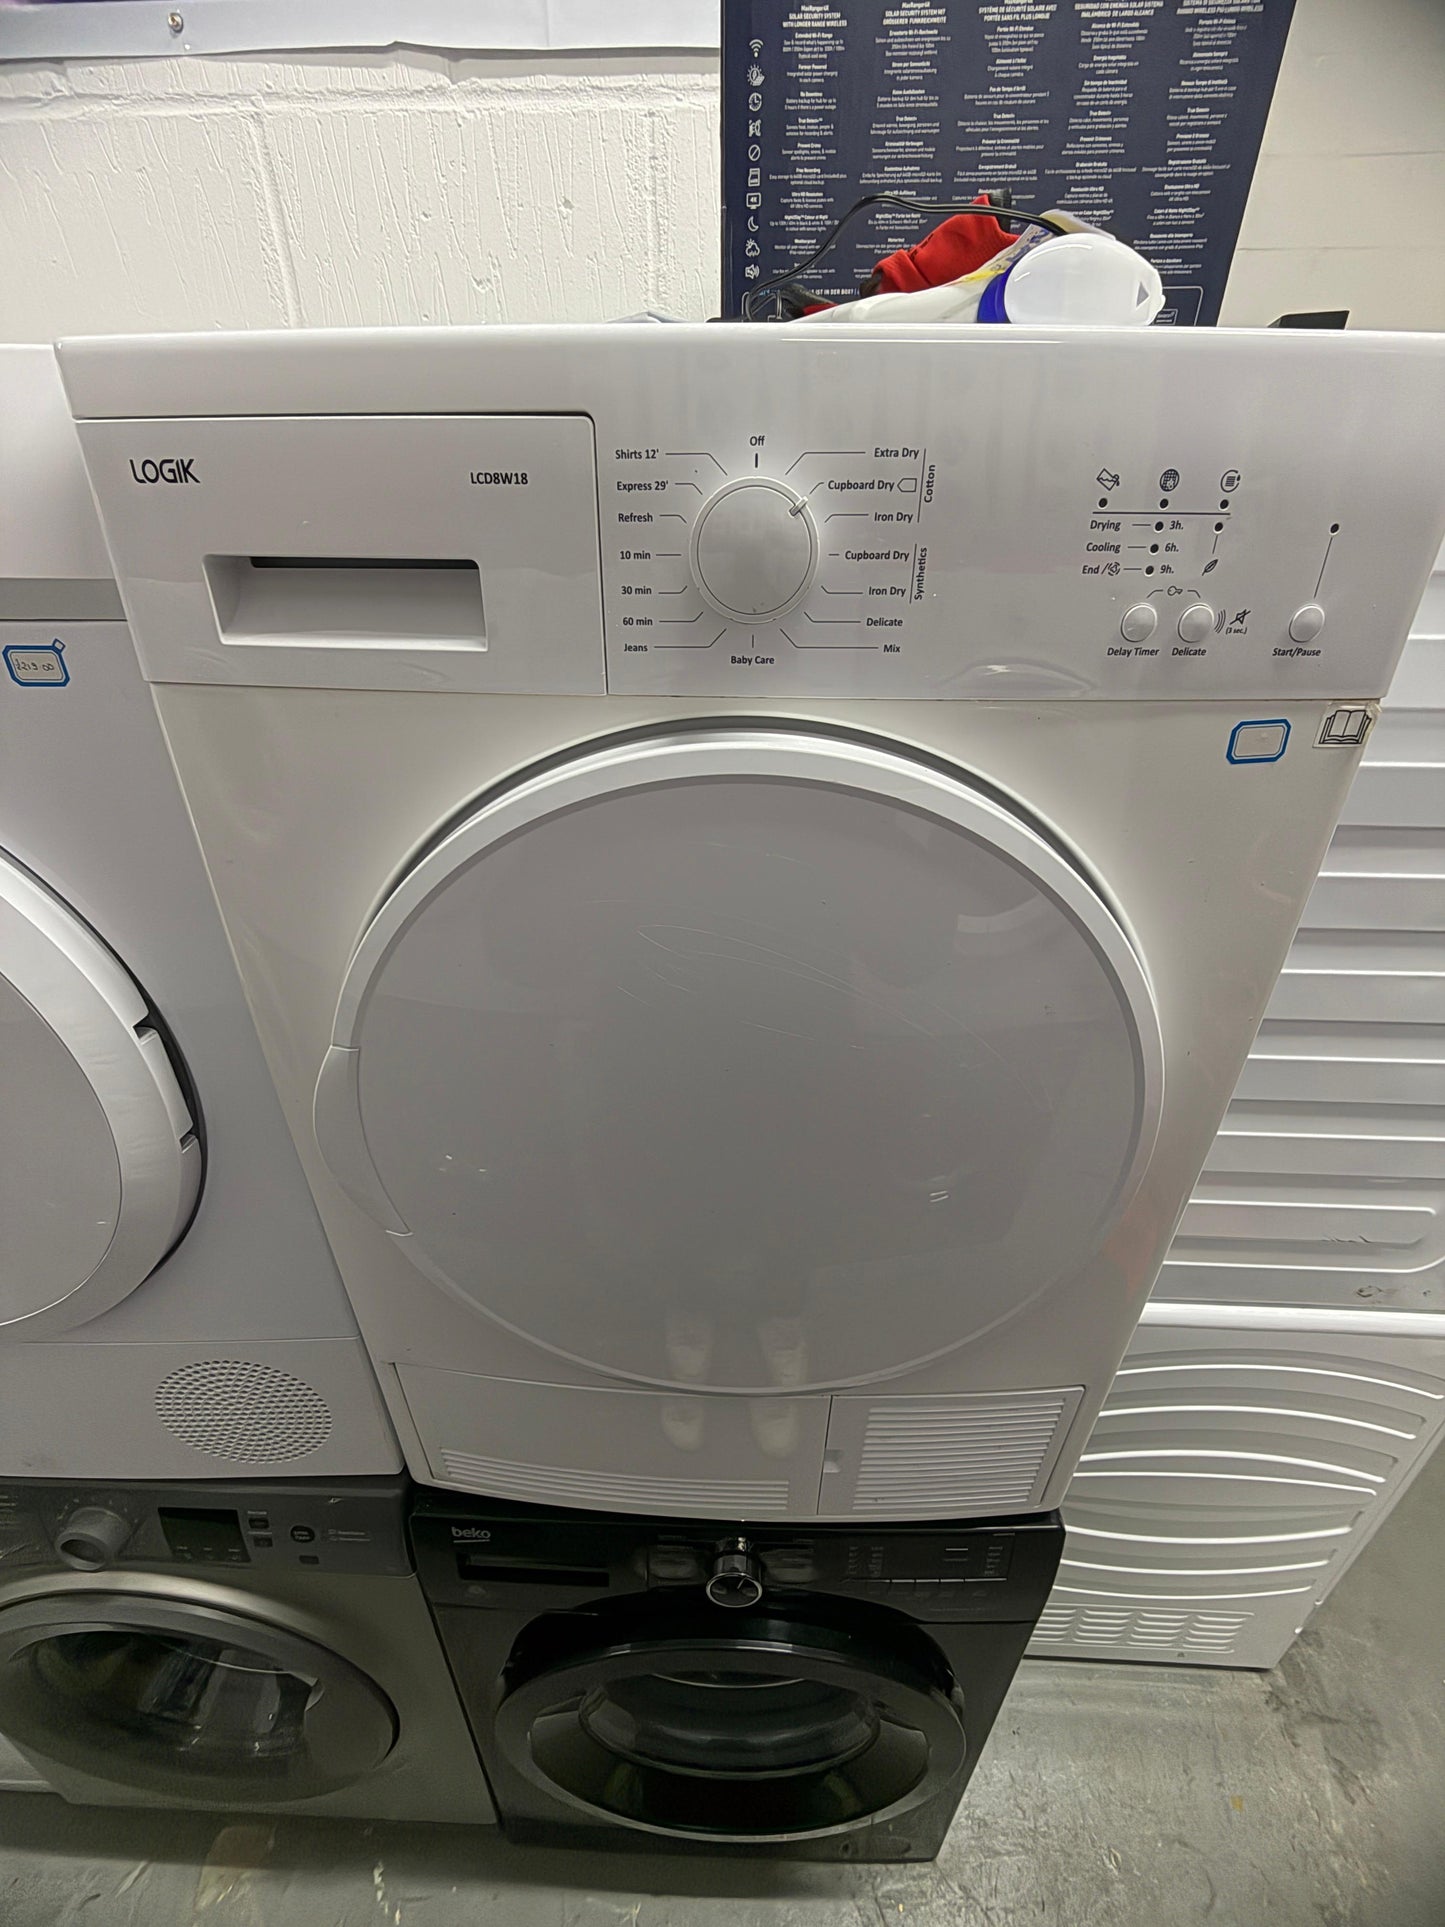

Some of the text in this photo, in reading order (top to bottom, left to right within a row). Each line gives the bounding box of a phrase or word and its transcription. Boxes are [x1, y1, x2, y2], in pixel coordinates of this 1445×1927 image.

[749, 436, 765, 447] Off
[615, 448, 659, 459] Shirts 12'
[874, 447, 919, 460] Extra Dry
[129, 459, 200, 484] LOGIK
[470, 472, 528, 485] LCD8W18
[924, 465, 936, 503] Cotton
[616, 480, 669, 492] Express 29'
[828, 479, 895, 492] Cupboard Dry
[618, 513, 653, 522] Refresh
[874, 512, 913, 523] Iron Dry
[1090, 520, 1121, 531] Drying
[1169, 520, 1184, 530] 3h.
[1086, 542, 1121, 554] Cooling
[1164, 543, 1179, 553] 6h.
[619, 551, 651, 560] 10 min
[845, 550, 910, 561] Cupboard Dry
[914, 548, 927, 600] Synthetics
[1082, 565, 1100, 575] End
[1160, 565, 1174, 575] 9h.
[621, 586, 652, 595] 30 min
[868, 586, 906, 597] Iron Dry
[622, 617, 653, 626] 60 min
[866, 617, 903, 627] Delicate
[623, 643, 648, 652] Jeans
[883, 644, 901, 653] Mix
[1107, 647, 1160, 658] Delay Timer
[1171, 647, 1207, 657] Delicate
[1272, 648, 1321, 658] Start/Pause
[730, 655, 775, 666] Baby Care
[451, 1526, 491, 1539] beko
